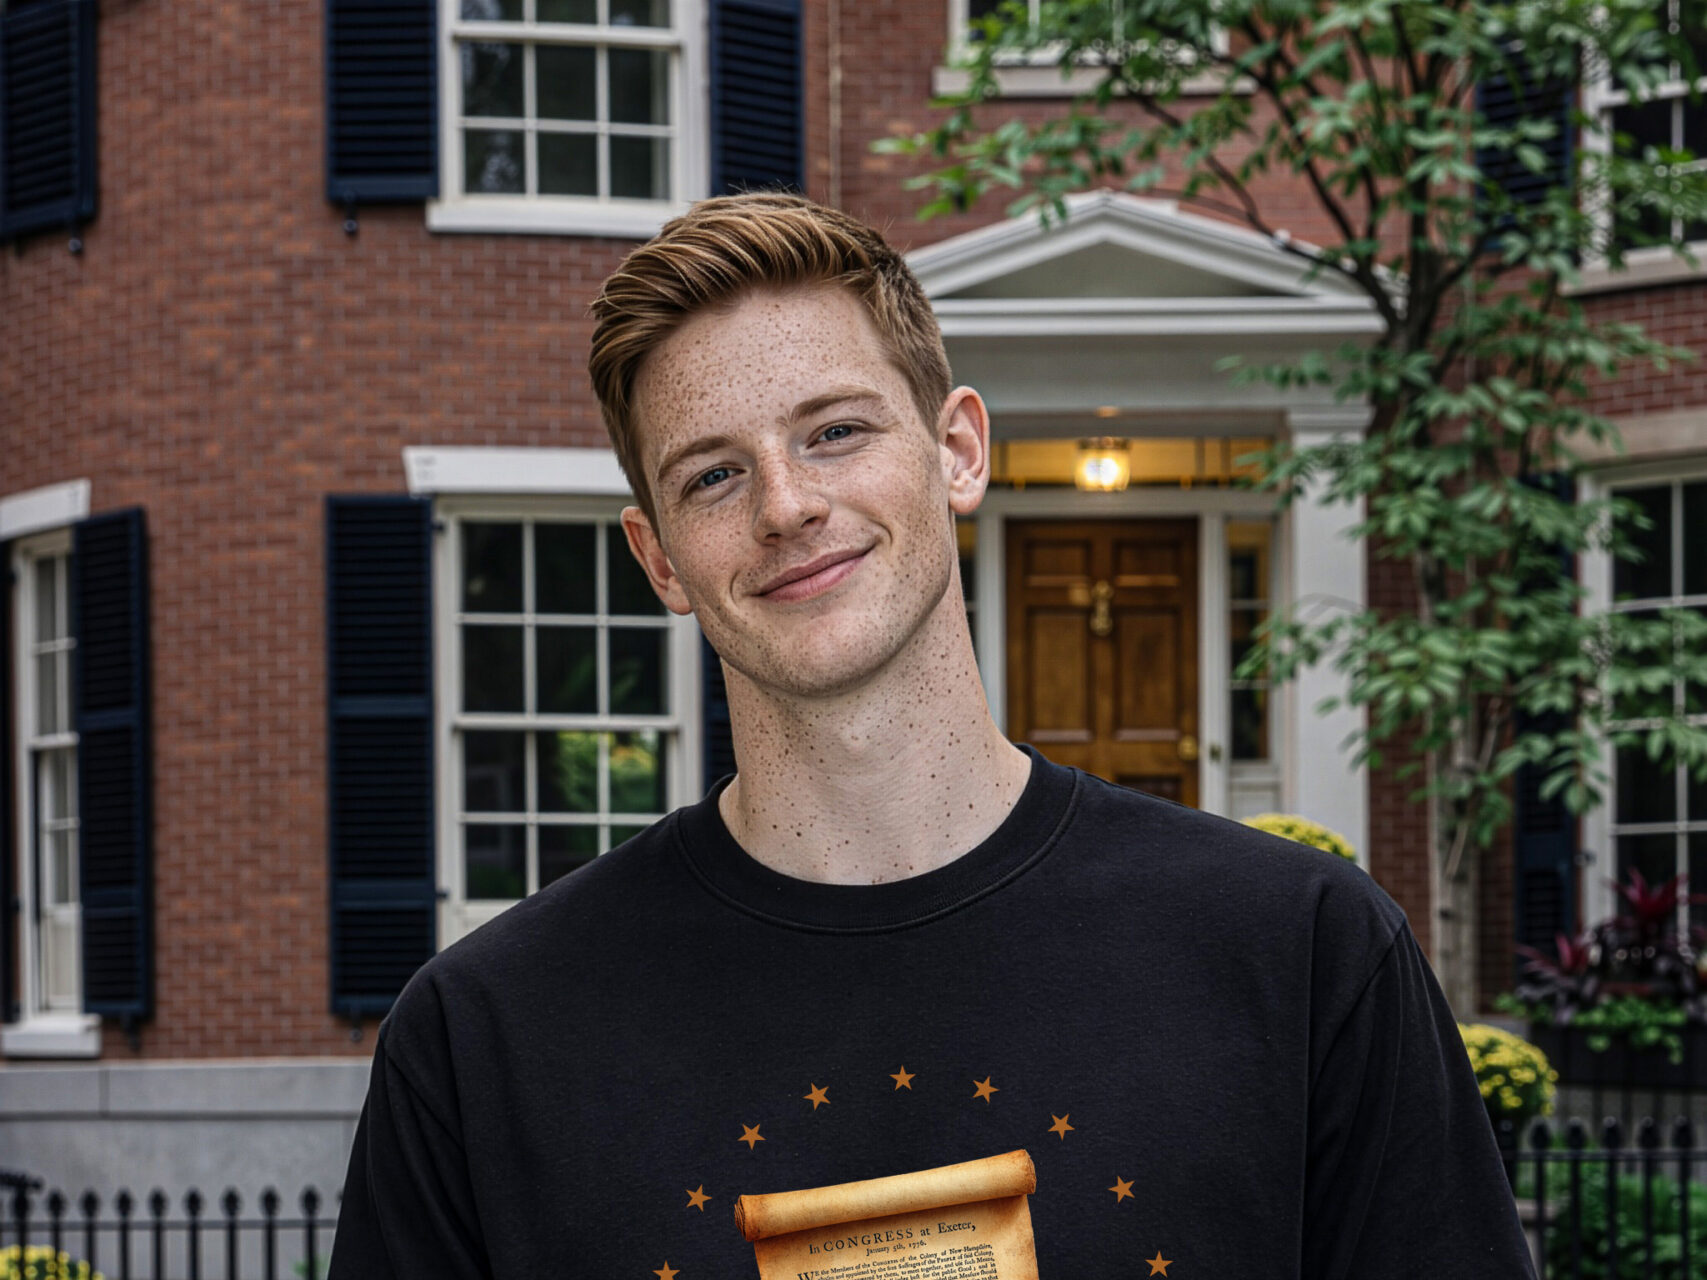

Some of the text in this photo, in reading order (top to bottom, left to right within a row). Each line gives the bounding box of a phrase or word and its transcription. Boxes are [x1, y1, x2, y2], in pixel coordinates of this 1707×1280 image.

[809, 1219, 976, 1255] In CONGRESS at Exeter,
